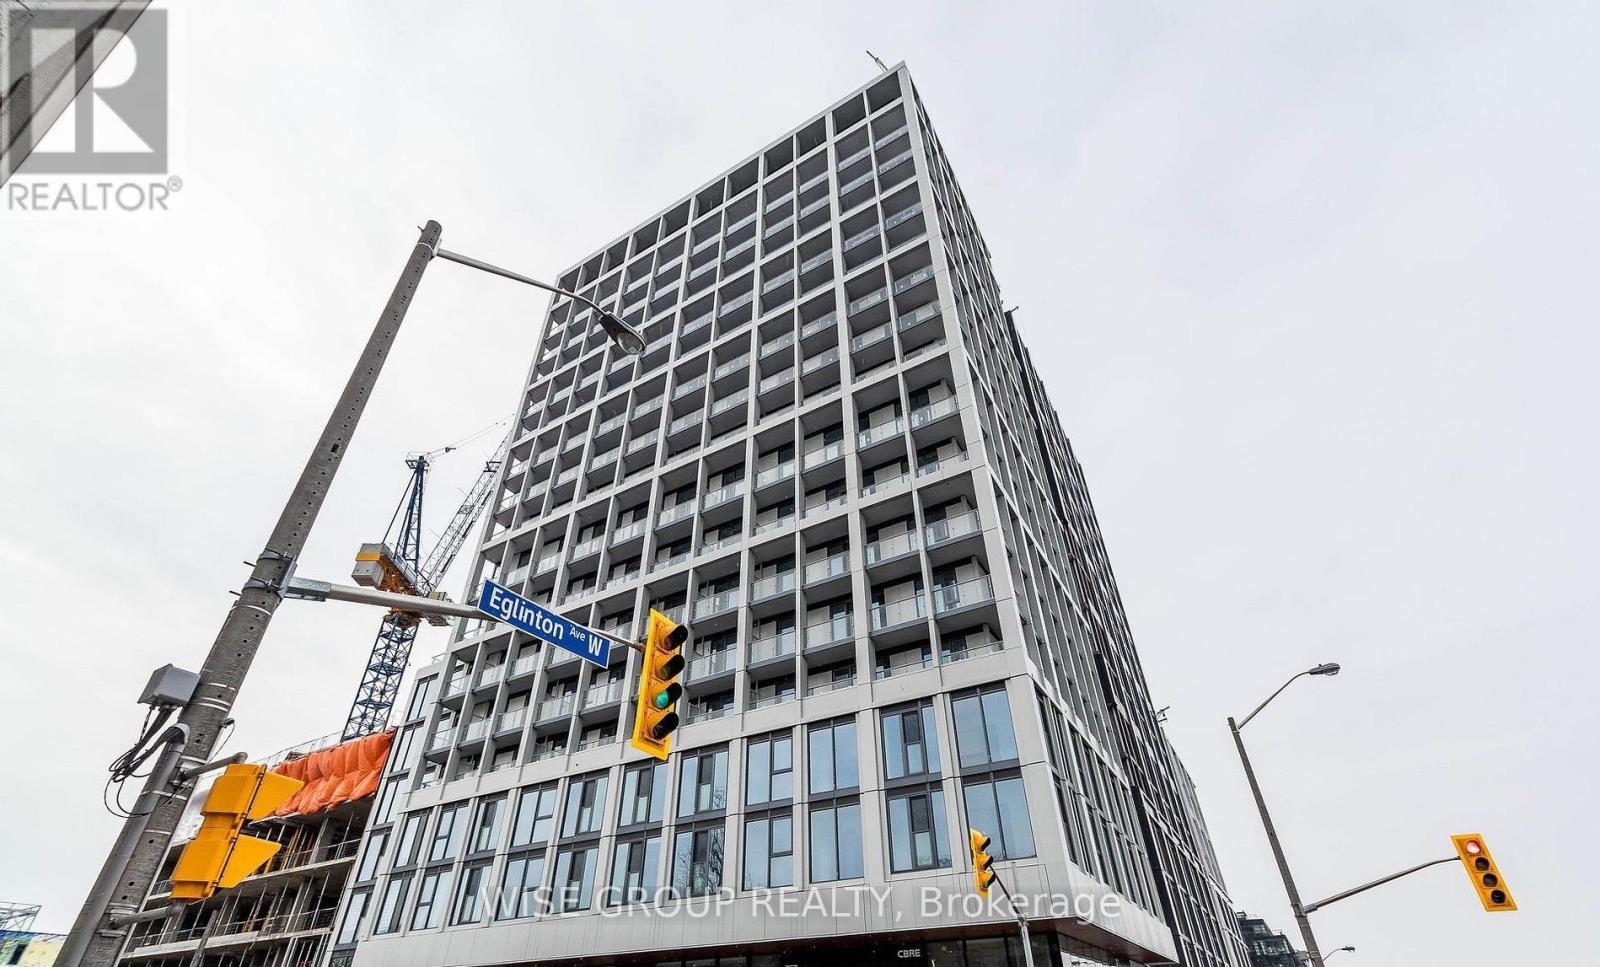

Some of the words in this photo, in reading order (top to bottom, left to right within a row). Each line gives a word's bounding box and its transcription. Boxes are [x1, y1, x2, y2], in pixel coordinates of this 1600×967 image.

[489, 586, 564, 640] Eglinton
[569, 627, 586, 642] Ave
[588, 634, 603, 657] W
[897, 948, 921, 959] CBRE
